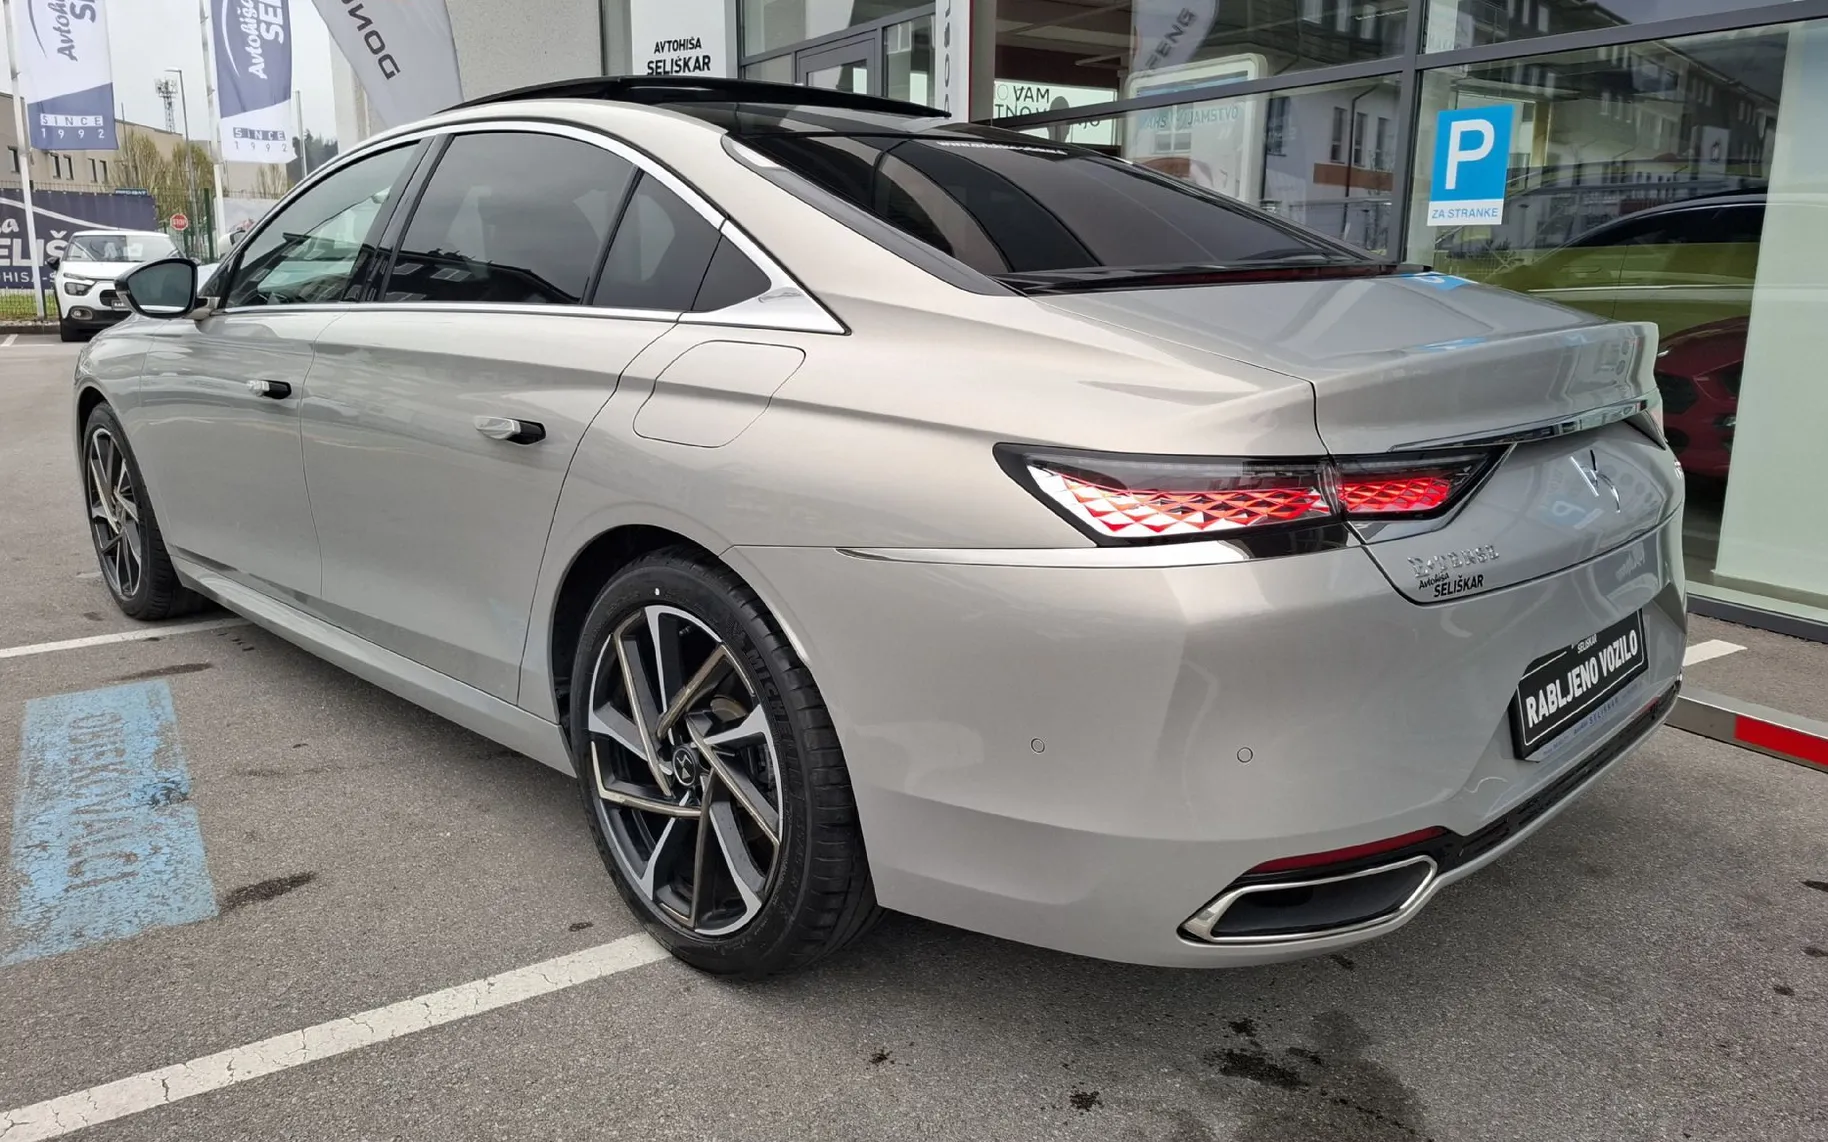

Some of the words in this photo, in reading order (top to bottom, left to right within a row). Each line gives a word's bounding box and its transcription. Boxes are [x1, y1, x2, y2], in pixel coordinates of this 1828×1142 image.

[654, 36, 702, 54] AVTOHIŠA
[646, 54, 711, 76] SELIŠKAR
[42, 115, 102, 126] SINCE
[41, 128, 105, 139] 1992
[235, 128, 285, 139] SINCE
[235, 141, 287, 152] 1992
[1445, 119, 1495, 190] P
[1432, 209, 1445, 219] ZA
[1447, 207, 1499, 219] STRANKE
[1433, 574, 1484, 598] SELIŠKAR
[1525, 655, 1600, 729] RABLJENO
[1599, 629, 1639, 677] VOZILO
